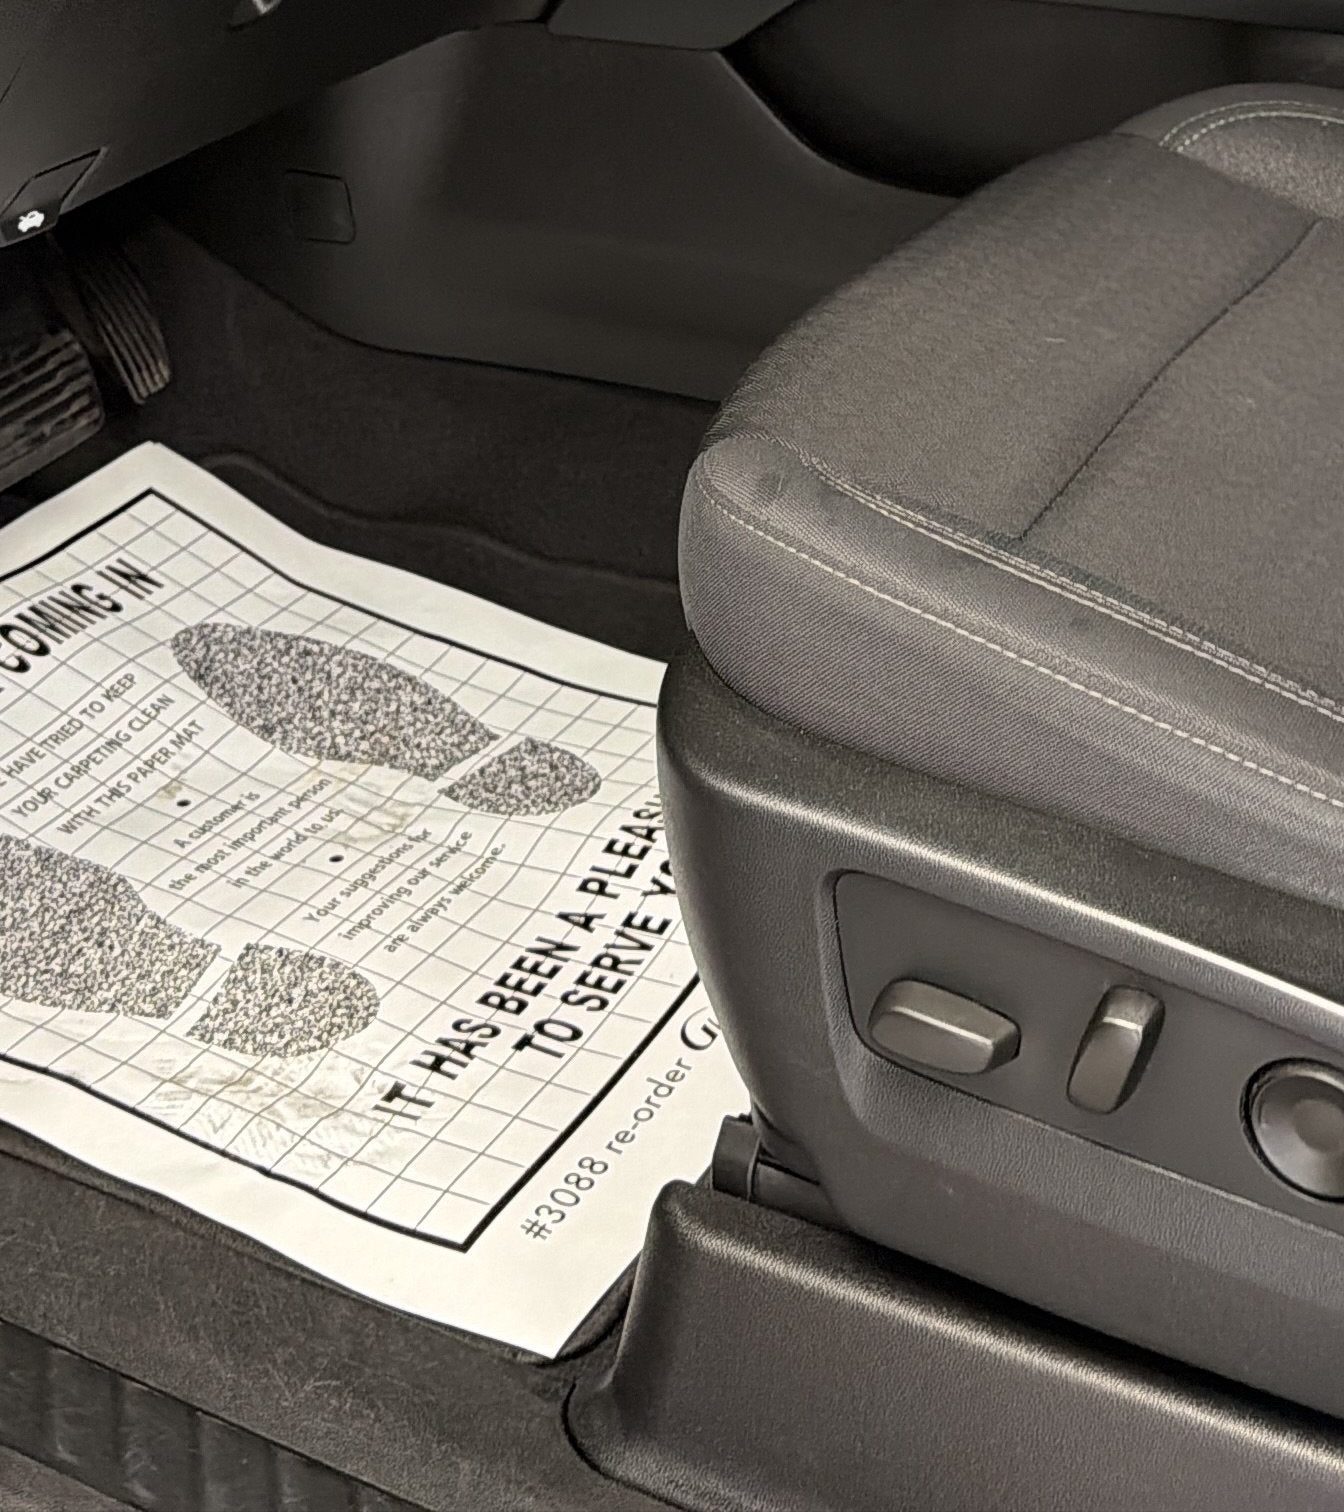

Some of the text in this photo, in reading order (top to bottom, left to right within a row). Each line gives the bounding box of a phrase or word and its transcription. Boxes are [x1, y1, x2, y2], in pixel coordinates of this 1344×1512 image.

[95, 556, 165, 602] IN
[1, 746, 47, 780] HAVE
[40, 716, 85, 751] TRIED
[79, 699, 106, 721] TO
[102, 672, 138, 704] KEEP
[11, 693, 175, 820] YOUR CARPETING CLEAN
[57, 719, 205, 836] WITH THIS PAPER MAT
[168, 778, 332, 892] the most important person
[173, 791, 261, 849] A customer is
[226, 878, 250, 889] in
[244, 859, 273, 878] the
[269, 831, 308, 862] world
[304, 823, 322, 835] to
[302, 827, 433, 924] Your suggestions for
[337, 830, 474, 942] improving our service
[383, 842, 507, 954] are always welcome.
[371, 1080, 436, 1122] IT
[408, 1018, 503, 1081] HAS
[476, 936, 582, 1016] BEEN
[556, 910, 607, 934] A
[511, 1017, 585, 1059] TO
[560, 910, 674, 1012] SERVE
[520, 1156, 610, 1241] #3088
[605, 1057, 693, 1155] re-order
